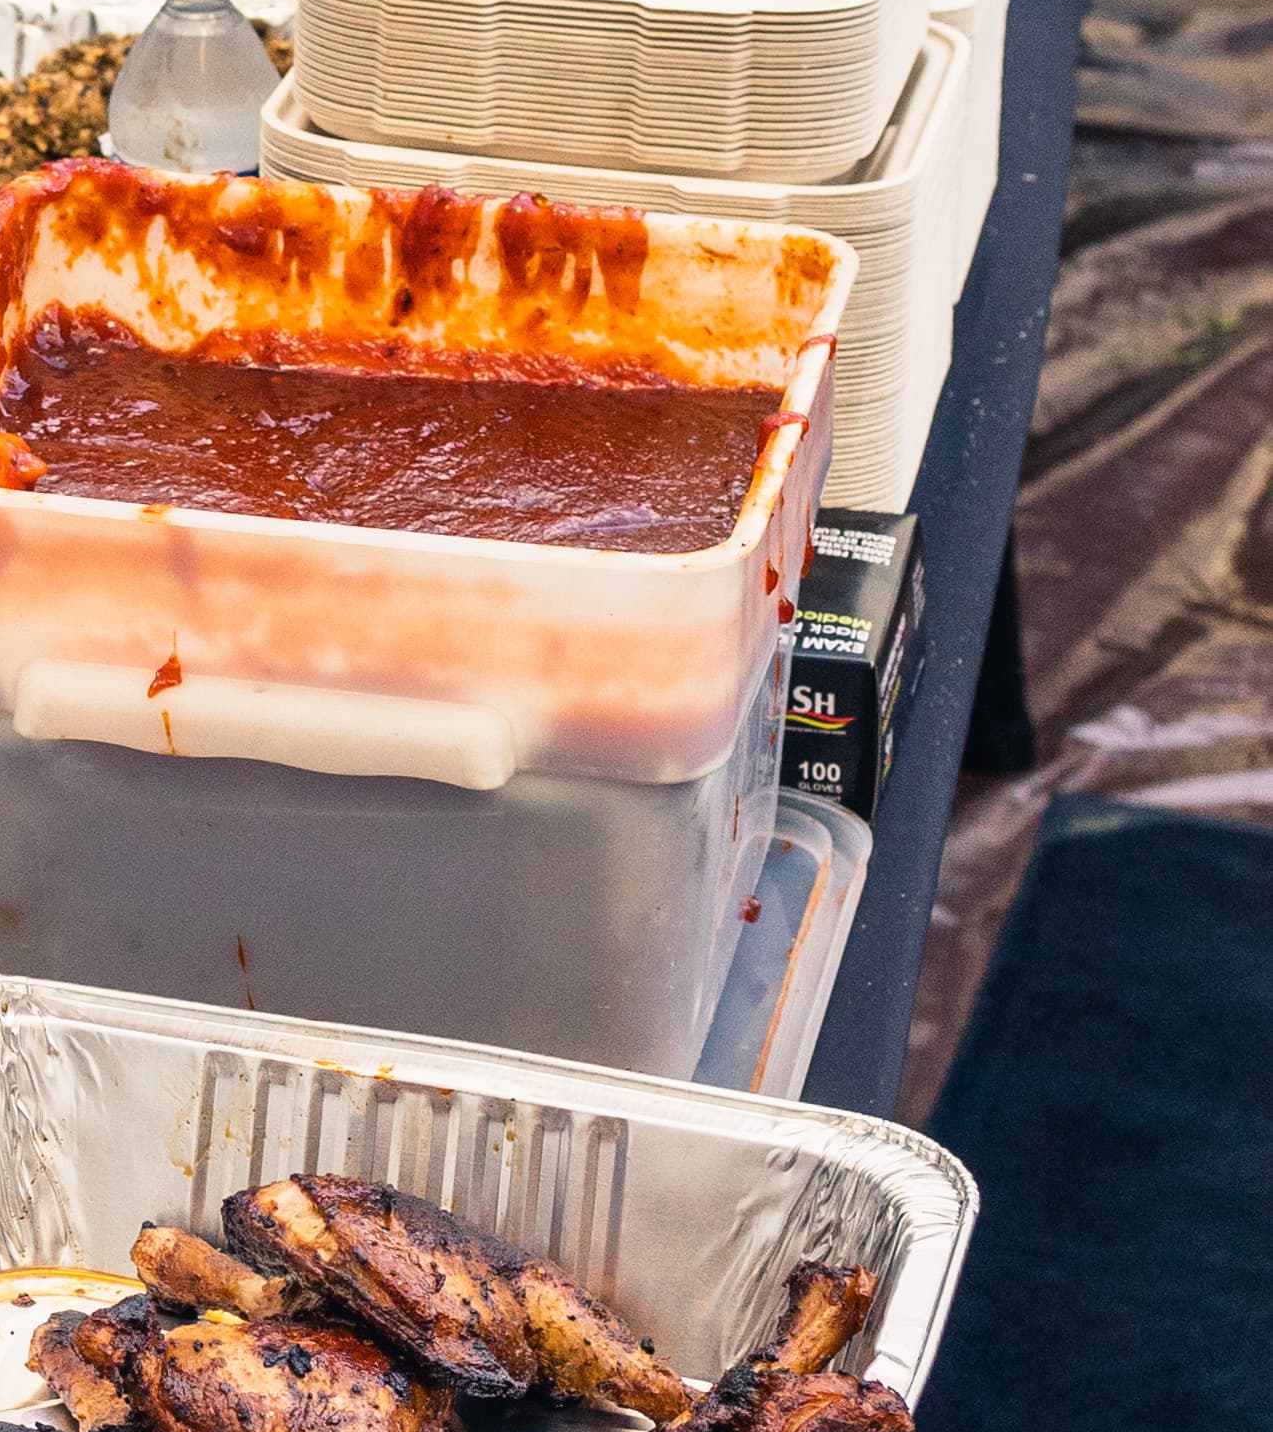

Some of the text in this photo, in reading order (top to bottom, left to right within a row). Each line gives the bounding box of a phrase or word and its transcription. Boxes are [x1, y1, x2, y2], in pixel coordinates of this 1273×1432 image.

[810, 623, 870, 642] Black
[802, 636, 865, 654] EXAM
[799, 760, 842, 782] 100
[798, 781, 843, 794] GLOVES
